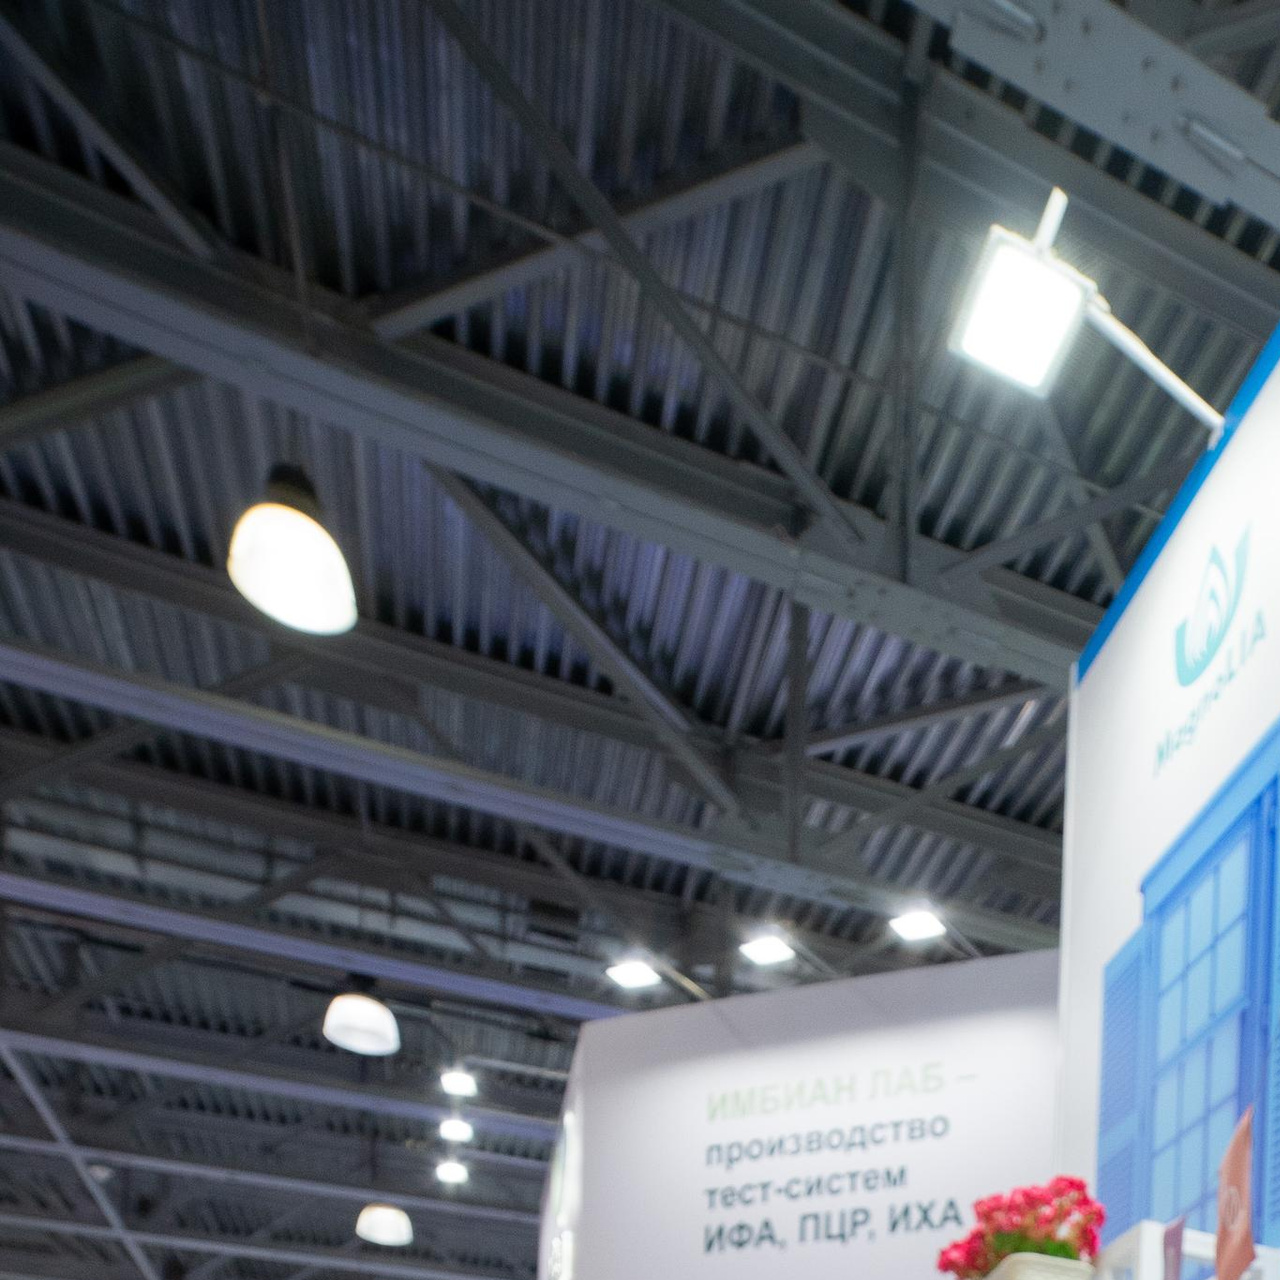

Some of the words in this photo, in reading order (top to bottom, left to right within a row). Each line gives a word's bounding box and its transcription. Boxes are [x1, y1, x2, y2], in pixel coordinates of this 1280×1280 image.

[706, 1071, 857, 1123] ИМБИАН
[869, 1061, 945, 1101] ЛАБ
[705, 1114, 951, 1171] производство
[704, 1165, 907, 1210] тест-систем
[703, 1217, 787, 1254] ИФА,
[798, 1207, 877, 1243] ПЦР,
[887, 1198, 963, 1233] ИХА
